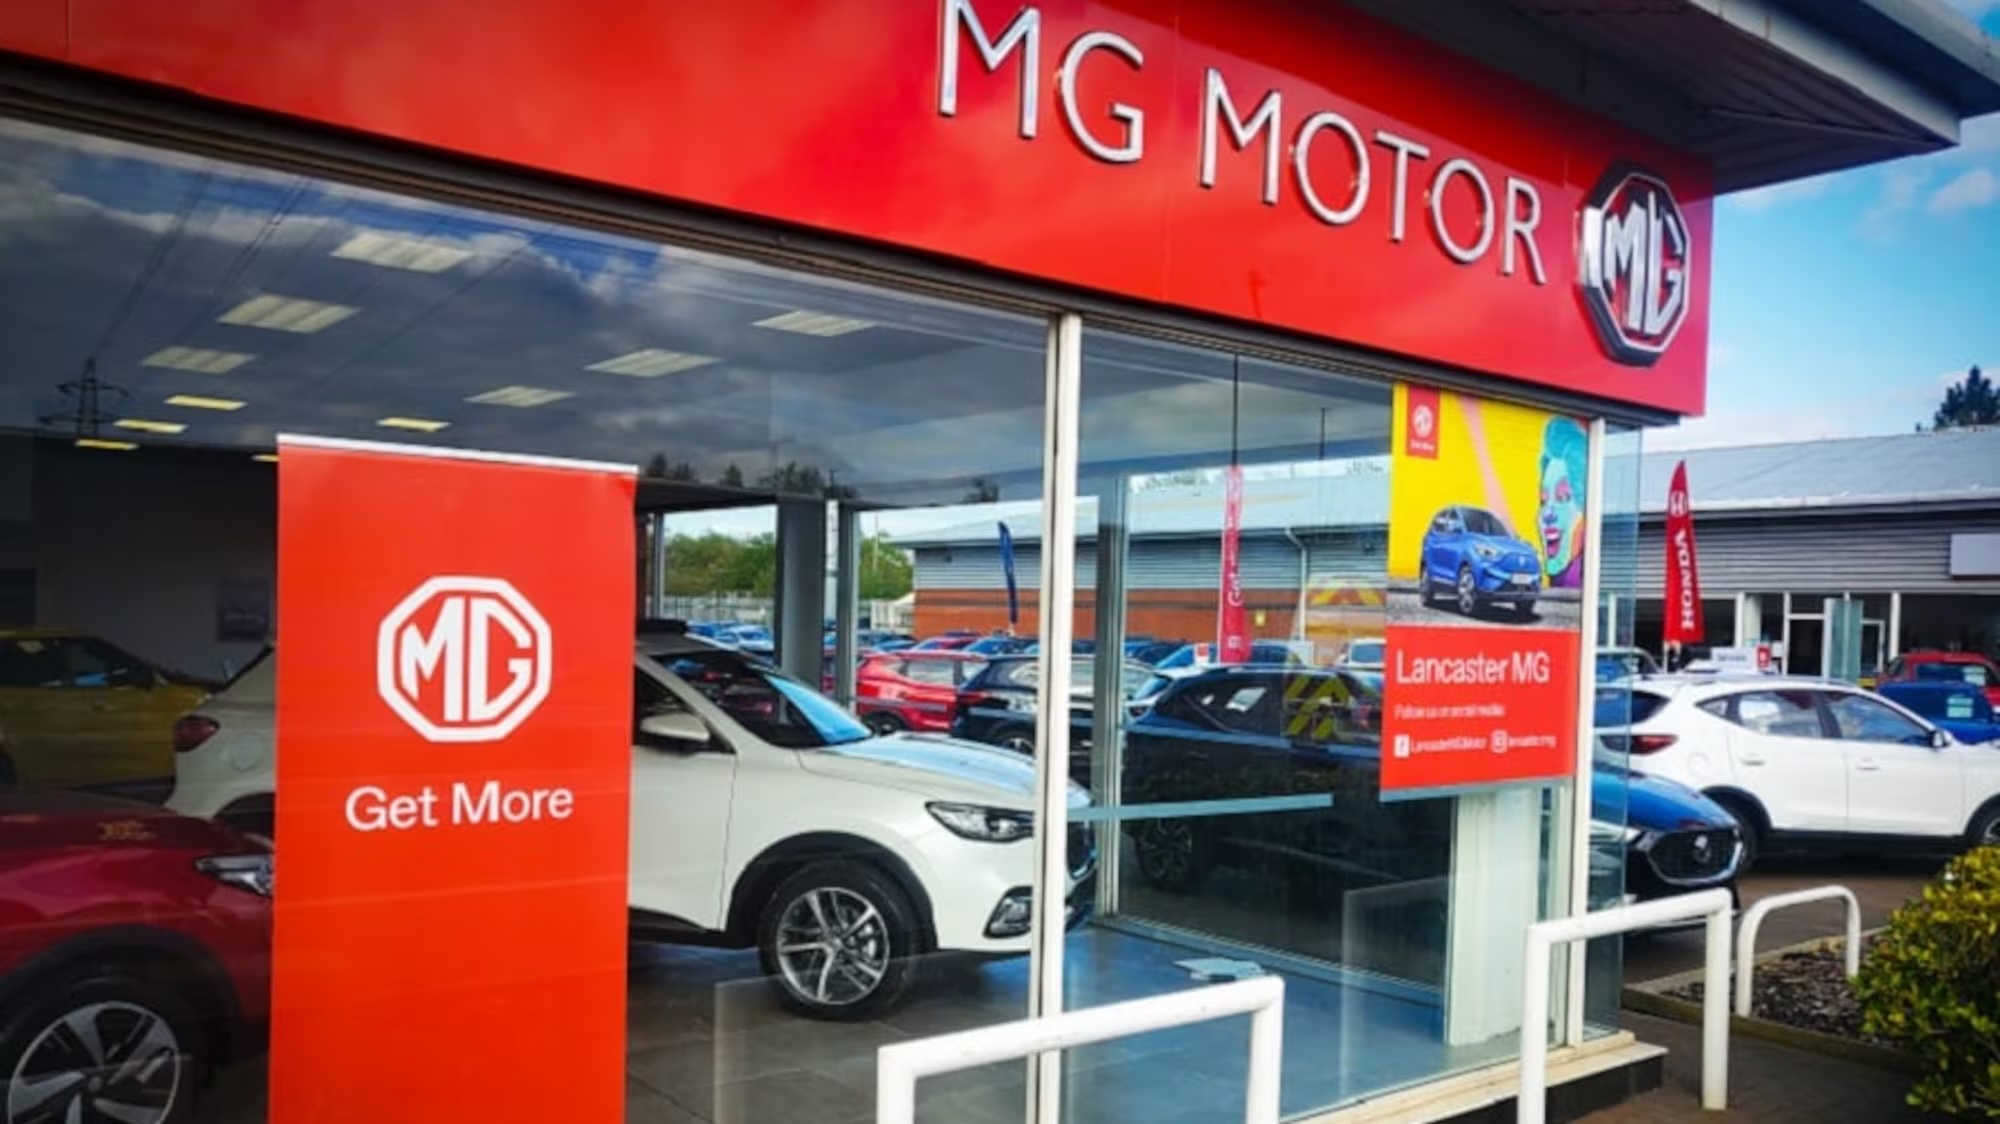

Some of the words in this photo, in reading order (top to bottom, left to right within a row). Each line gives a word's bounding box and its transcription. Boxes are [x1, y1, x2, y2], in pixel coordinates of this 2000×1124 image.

[938, 0, 1144, 162] MG
[1202, 68, 1546, 284] MOTOR
[1603, 191, 1685, 335] MG
[1675, 529, 1695, 630] HONDA
[400, 596, 532, 723] MG
[1396, 650, 1508, 684] Lancaster
[1512, 650, 1550, 683] MG
[345, 785, 438, 831] Get
[452, 780, 574, 824] More
